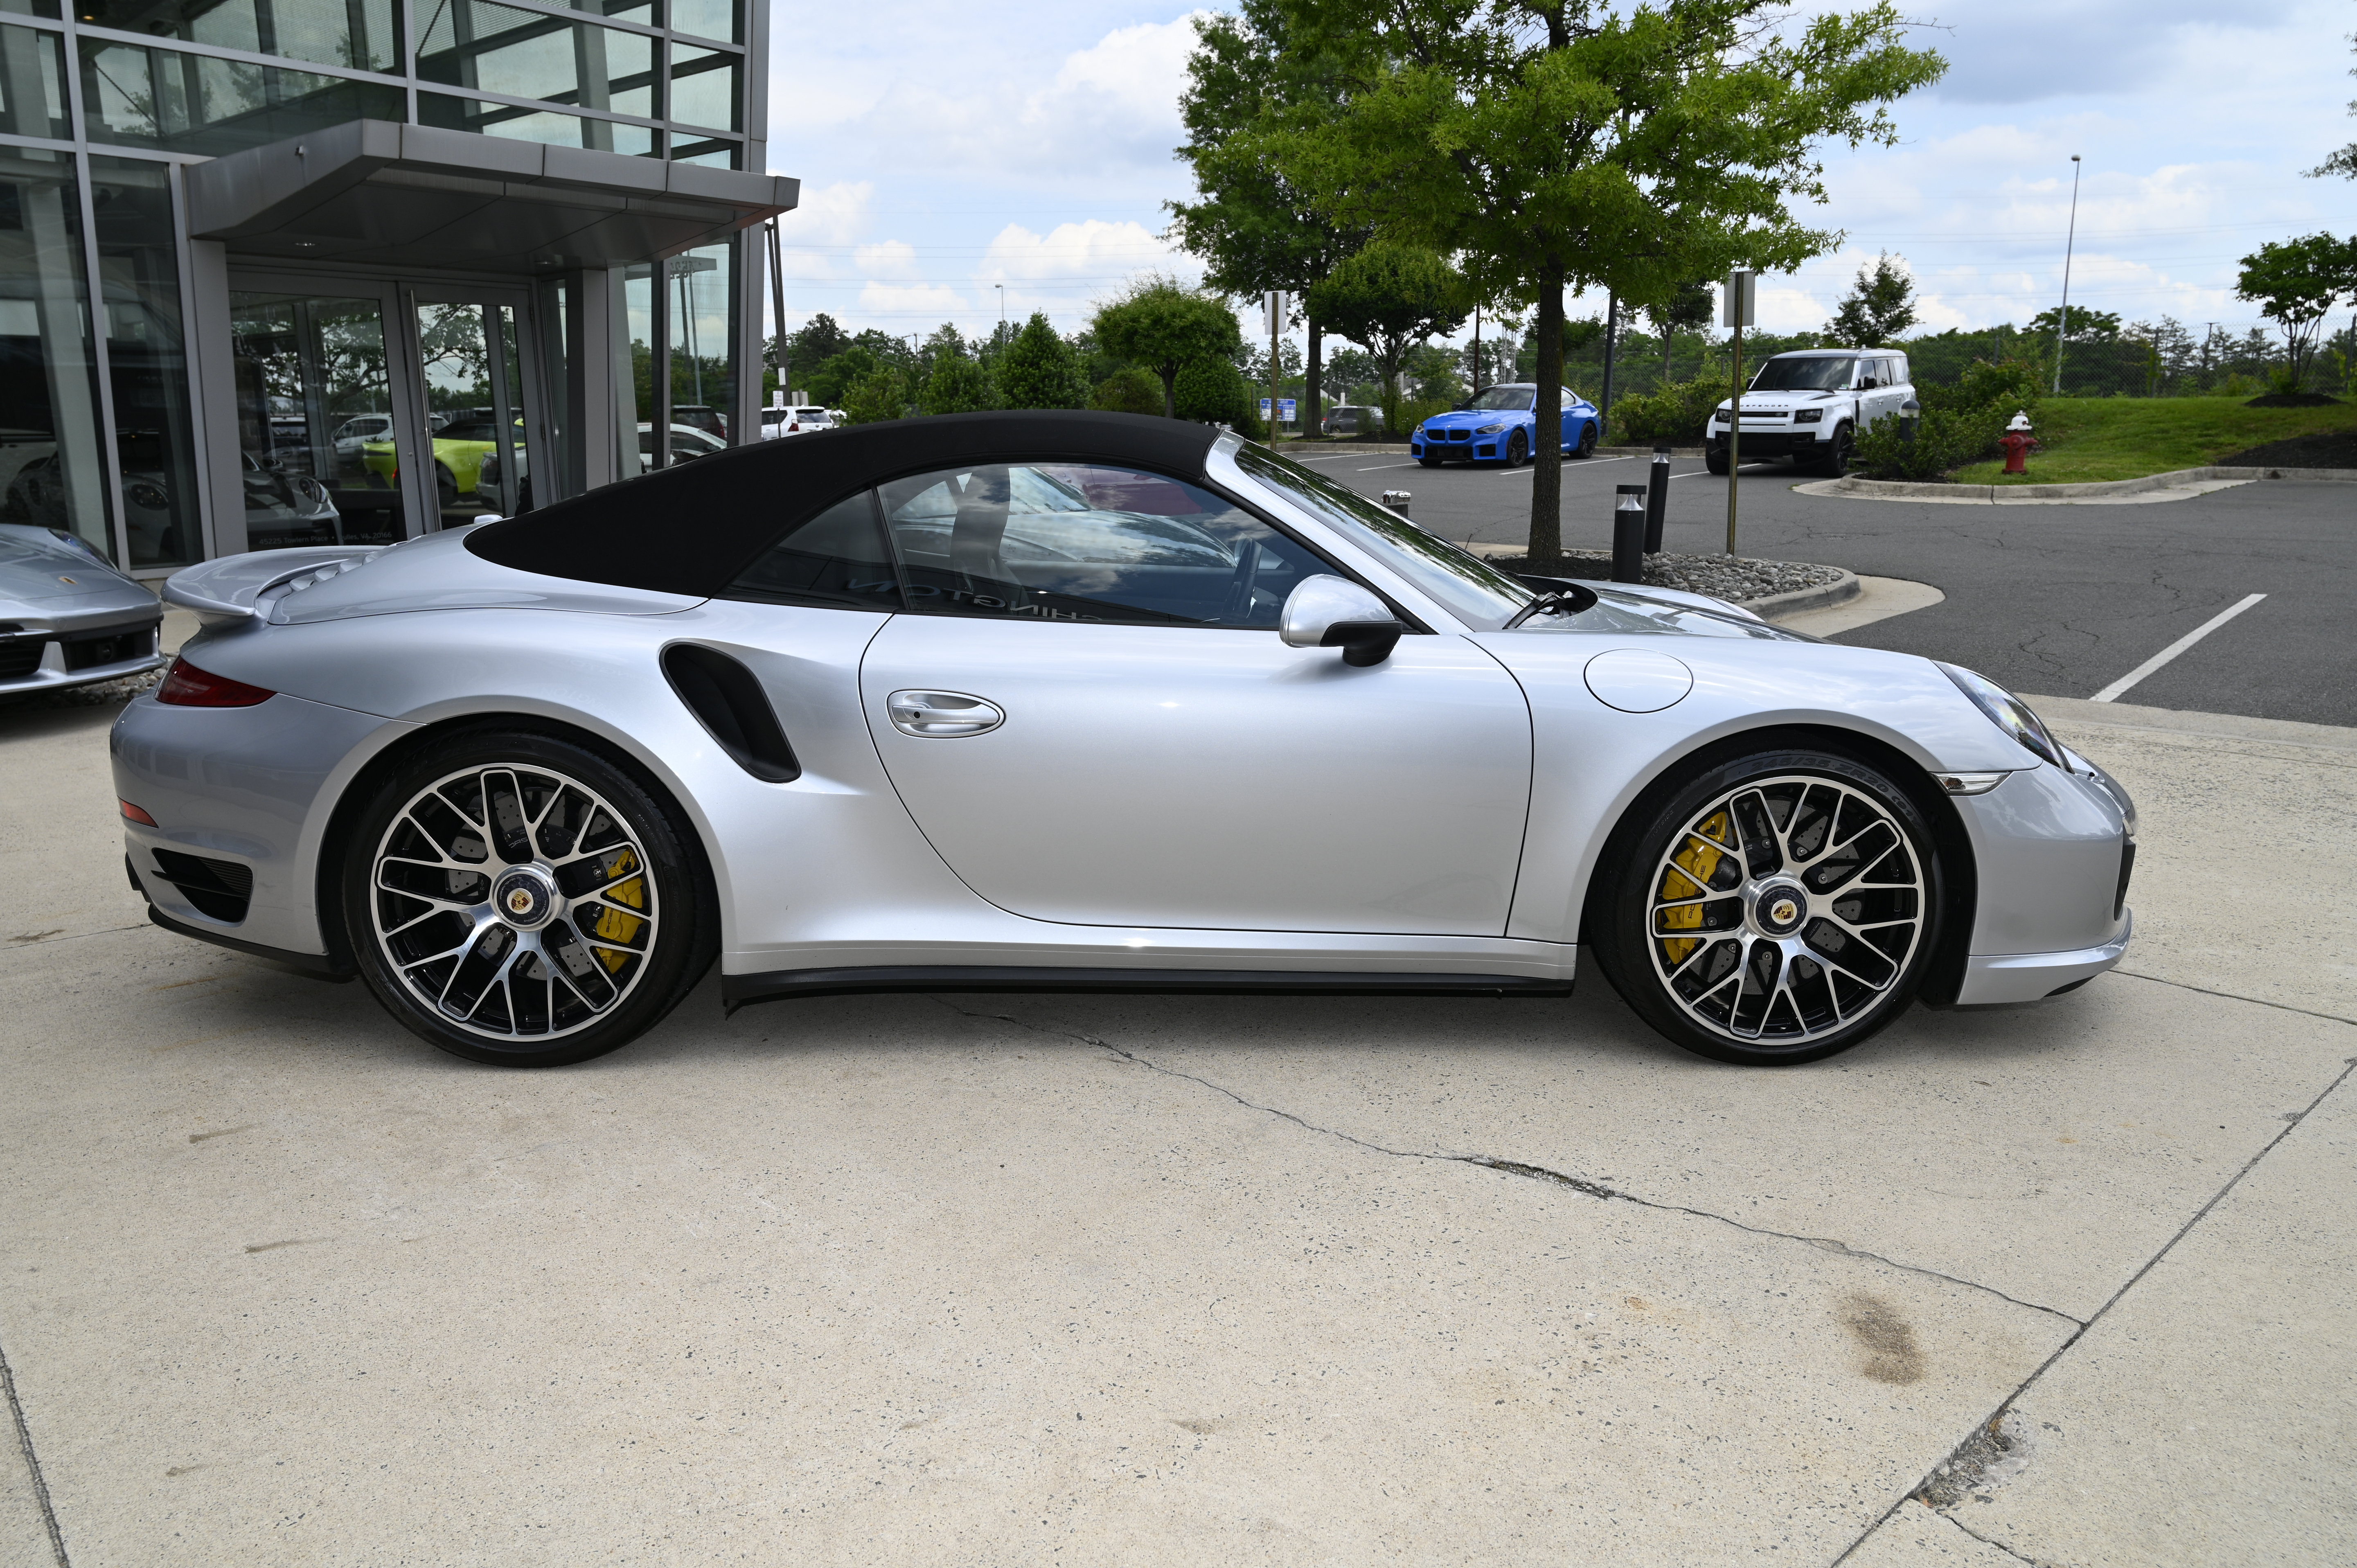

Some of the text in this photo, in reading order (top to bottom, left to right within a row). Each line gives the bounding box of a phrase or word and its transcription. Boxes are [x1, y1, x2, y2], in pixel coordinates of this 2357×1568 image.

[1750, 757, 1831, 773] 245/35
[1834, 763, 1889, 793] ZR20
[1650, 809, 1674, 839] OUTSIDE
[1688, 865, 1706, 919] POSHE
